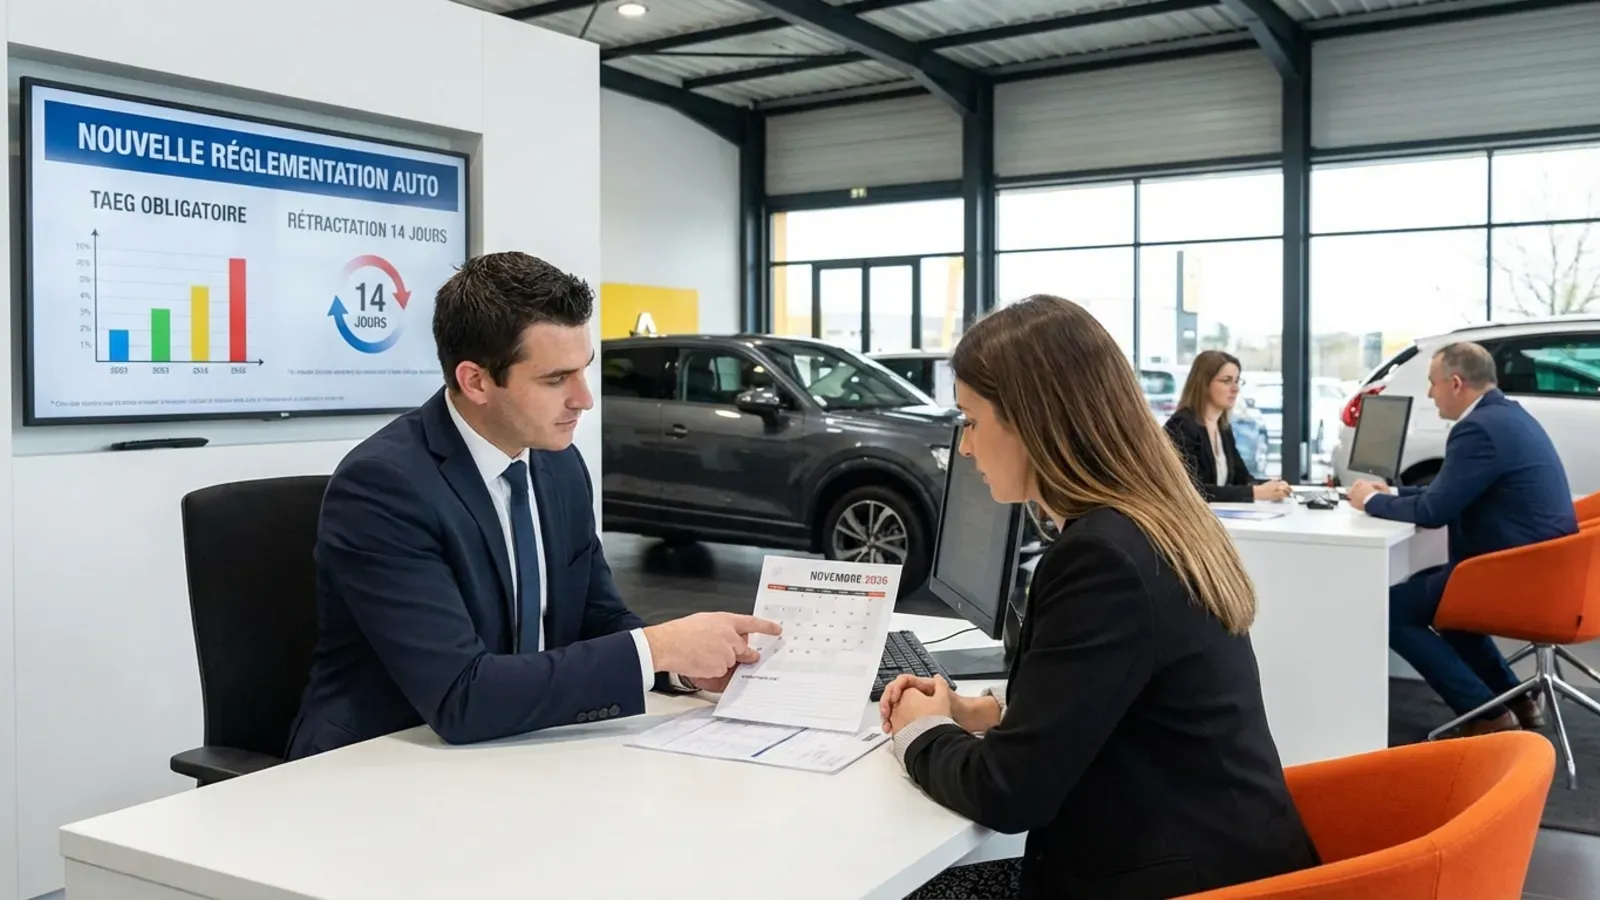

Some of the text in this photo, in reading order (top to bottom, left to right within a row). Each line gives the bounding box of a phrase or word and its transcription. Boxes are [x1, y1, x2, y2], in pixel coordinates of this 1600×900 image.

[78, 122, 439, 198] NOUVELLE RÉGLEMENTATION AUTO
[90, 190, 247, 223] TAEG OBLIGATOIRE
[287, 208, 448, 244] RÉTRACTATION 14 JOURS
[355, 282, 386, 312] 14
